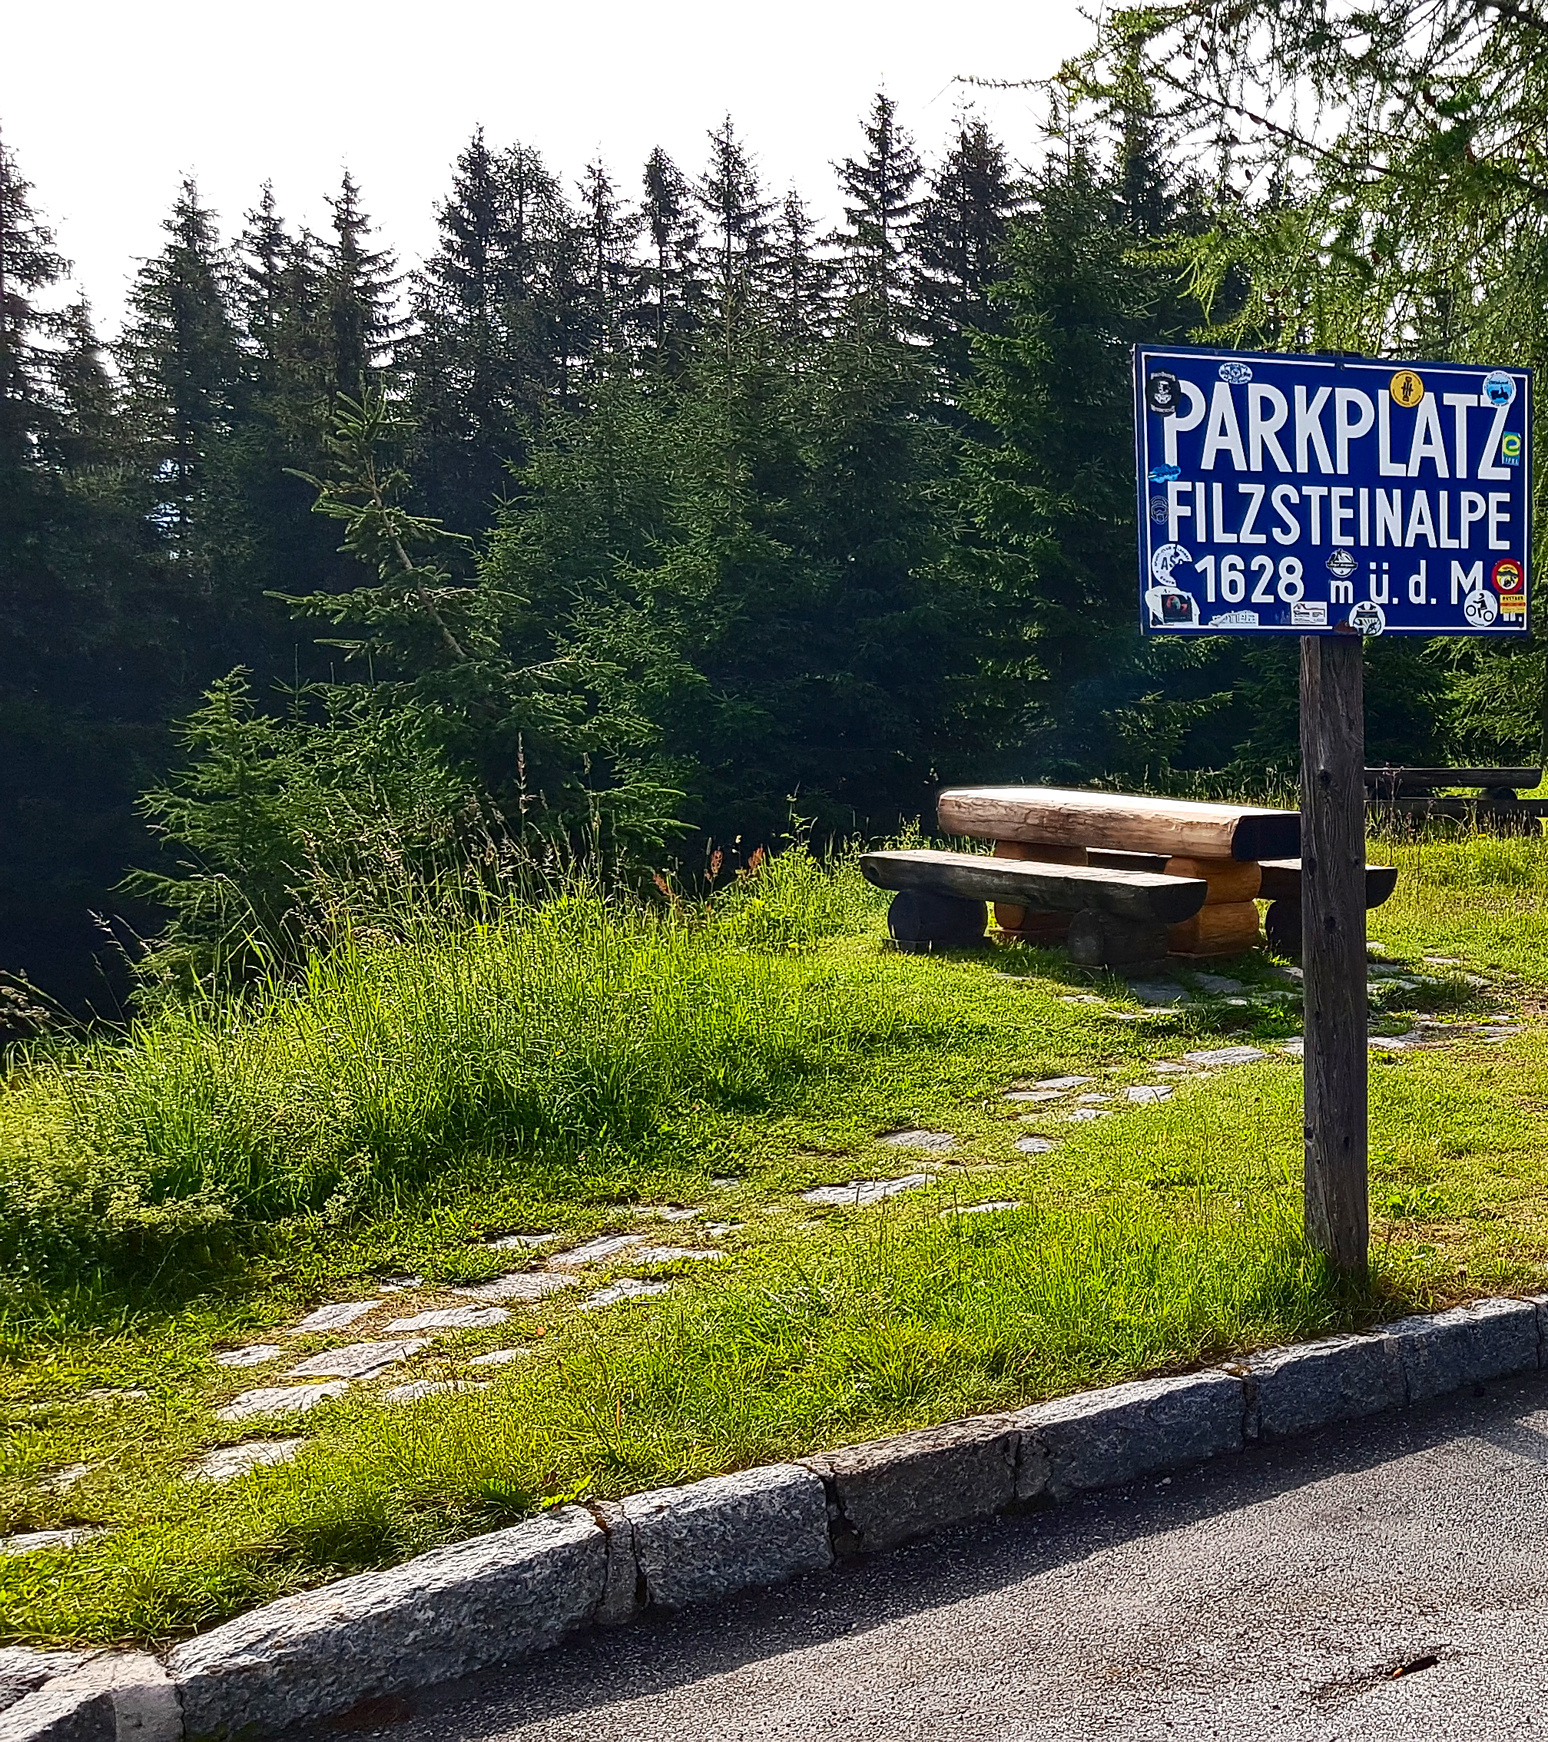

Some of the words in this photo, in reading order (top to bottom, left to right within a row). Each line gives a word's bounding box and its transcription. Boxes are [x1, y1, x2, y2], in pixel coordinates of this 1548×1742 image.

[1163, 379, 1511, 480] PARKPLATZ
[1167, 481, 1511, 550] FILZSTEINALPE
[1194, 554, 1305, 603] 1628
[1330, 580, 1353, 603] m
